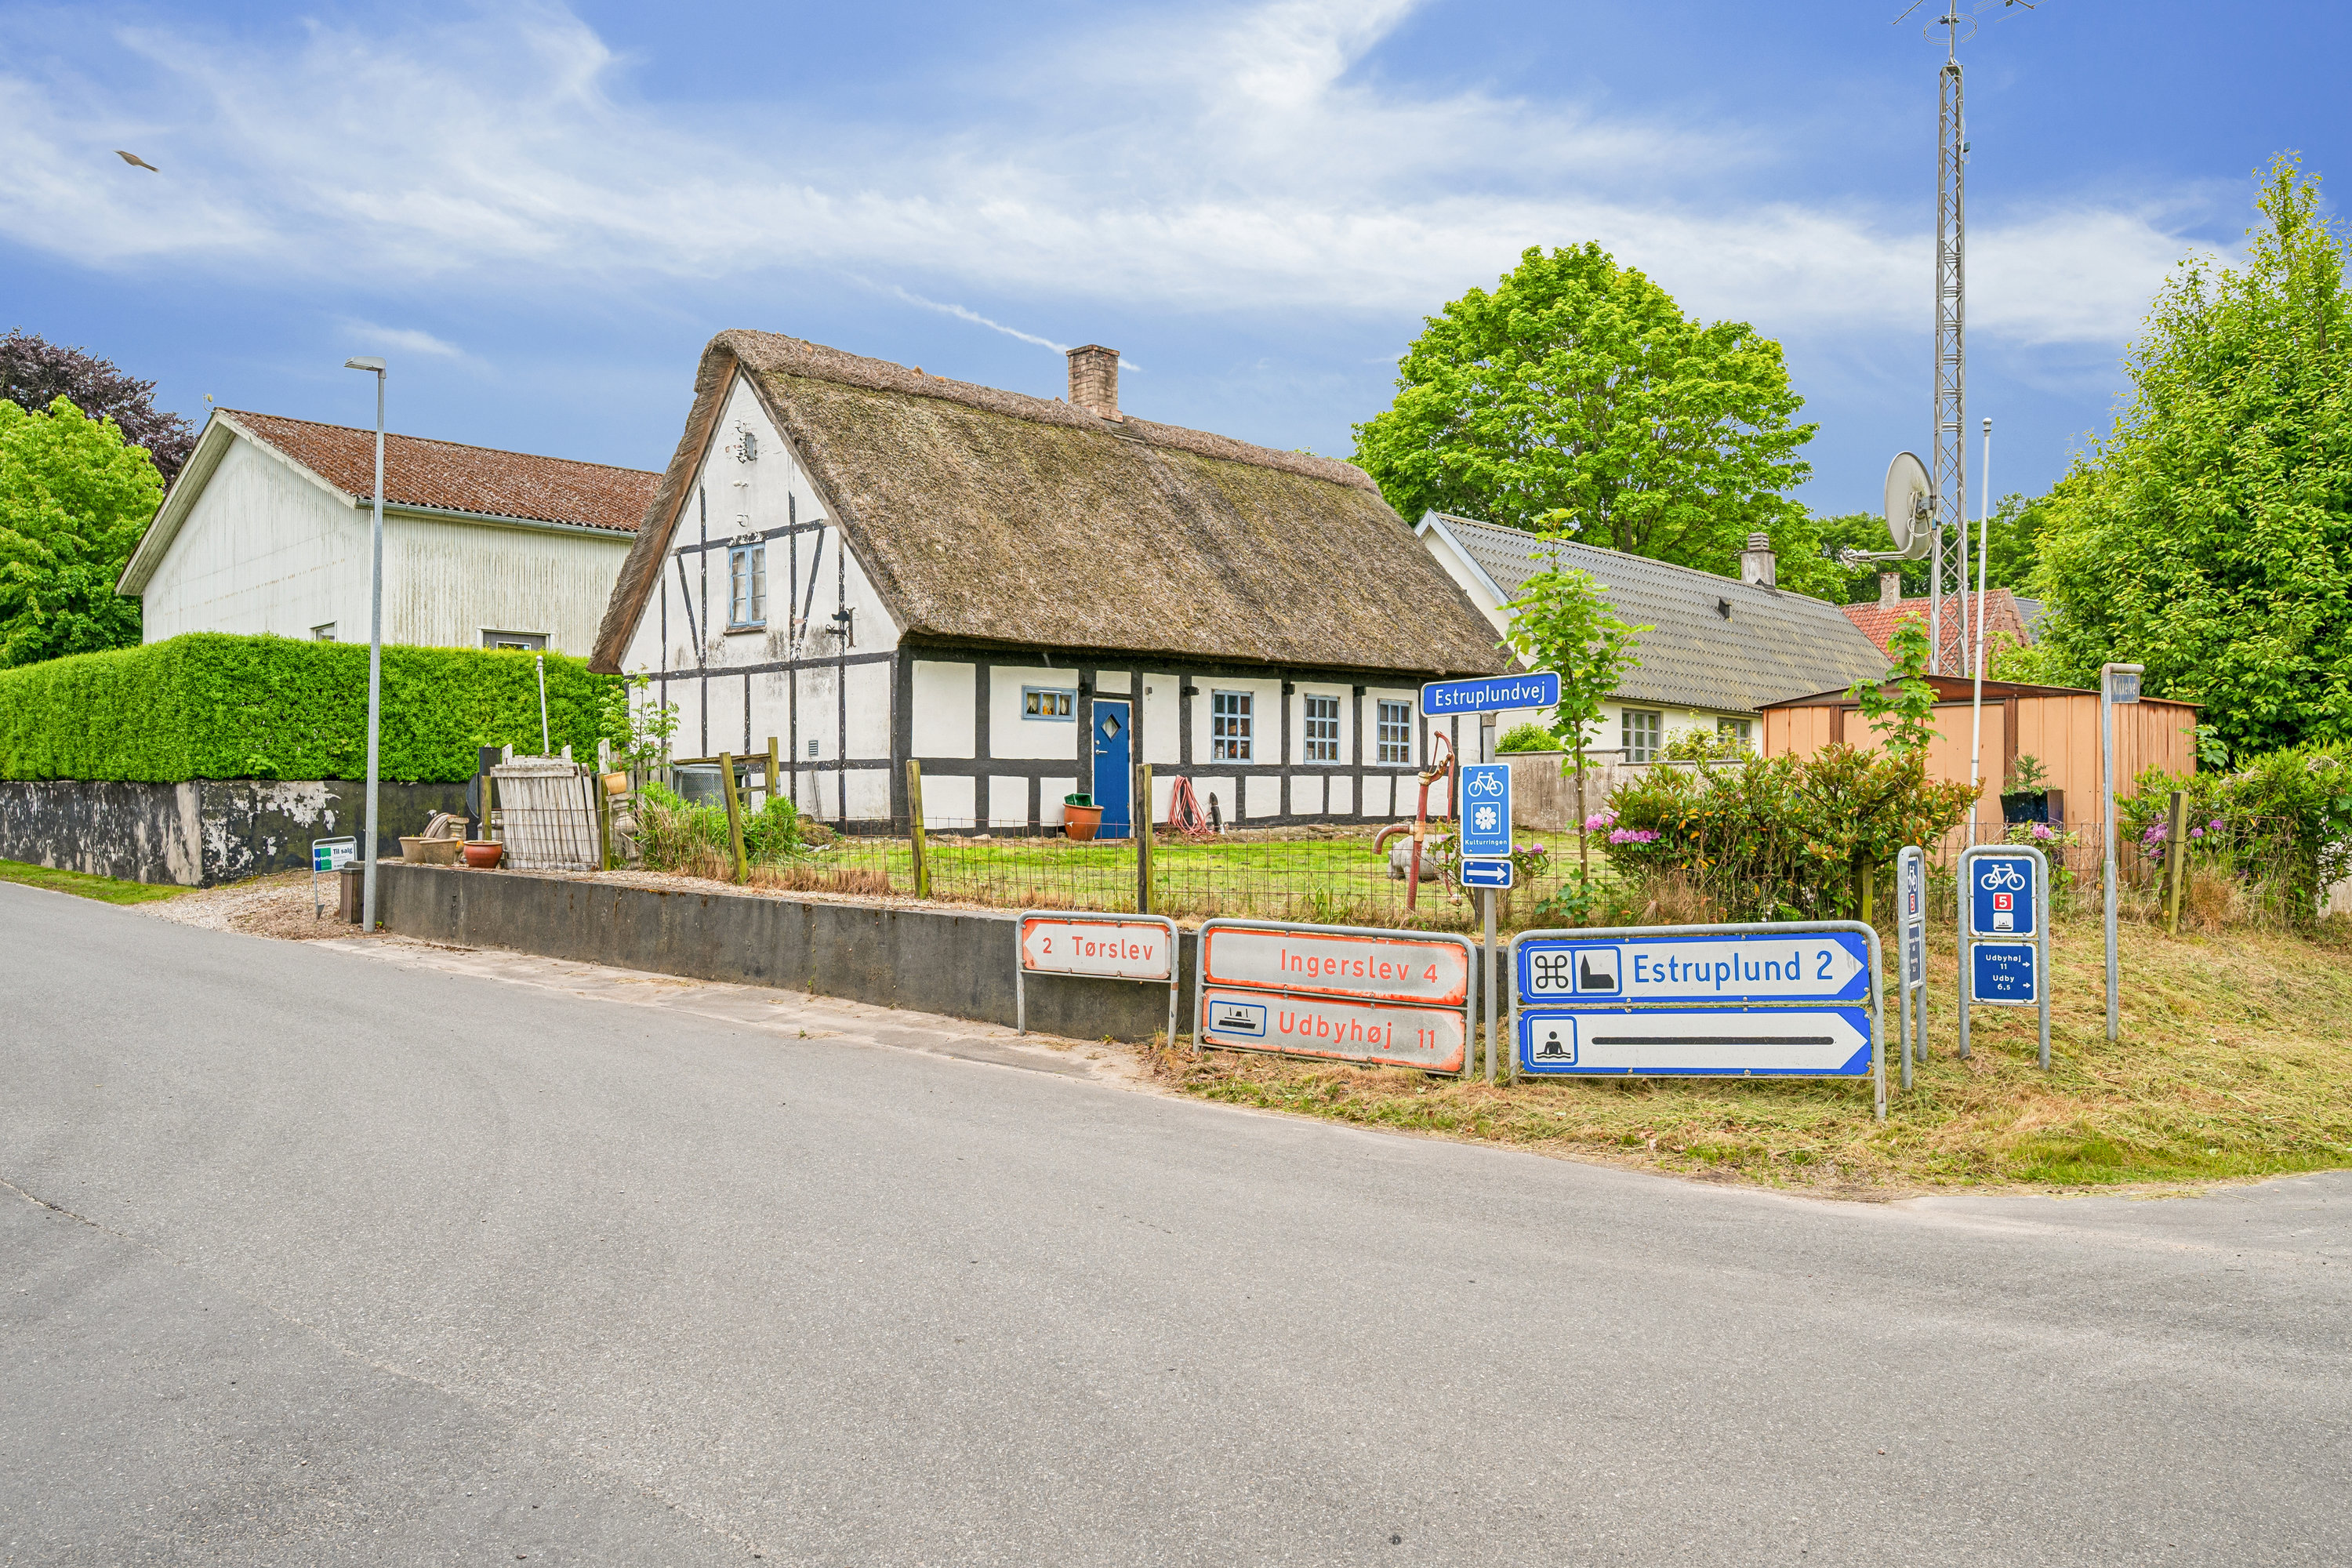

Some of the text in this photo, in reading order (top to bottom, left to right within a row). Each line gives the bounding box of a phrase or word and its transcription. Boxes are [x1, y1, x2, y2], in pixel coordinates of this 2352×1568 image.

[1436, 681, 1545, 709] Estruplundvej
[1998, 896, 2008, 908] 5
[1043, 936, 1153, 960] 2 Tørslev
[1985, 954, 2021, 963] Udbyhøj
[1281, 949, 1438, 983] Ingerslev 4
[1634, 950, 1833, 991] Estruplund 2
[1992, 975, 2015, 983] Udby
[1279, 1011, 1436, 1050] Udbyhøj 11
